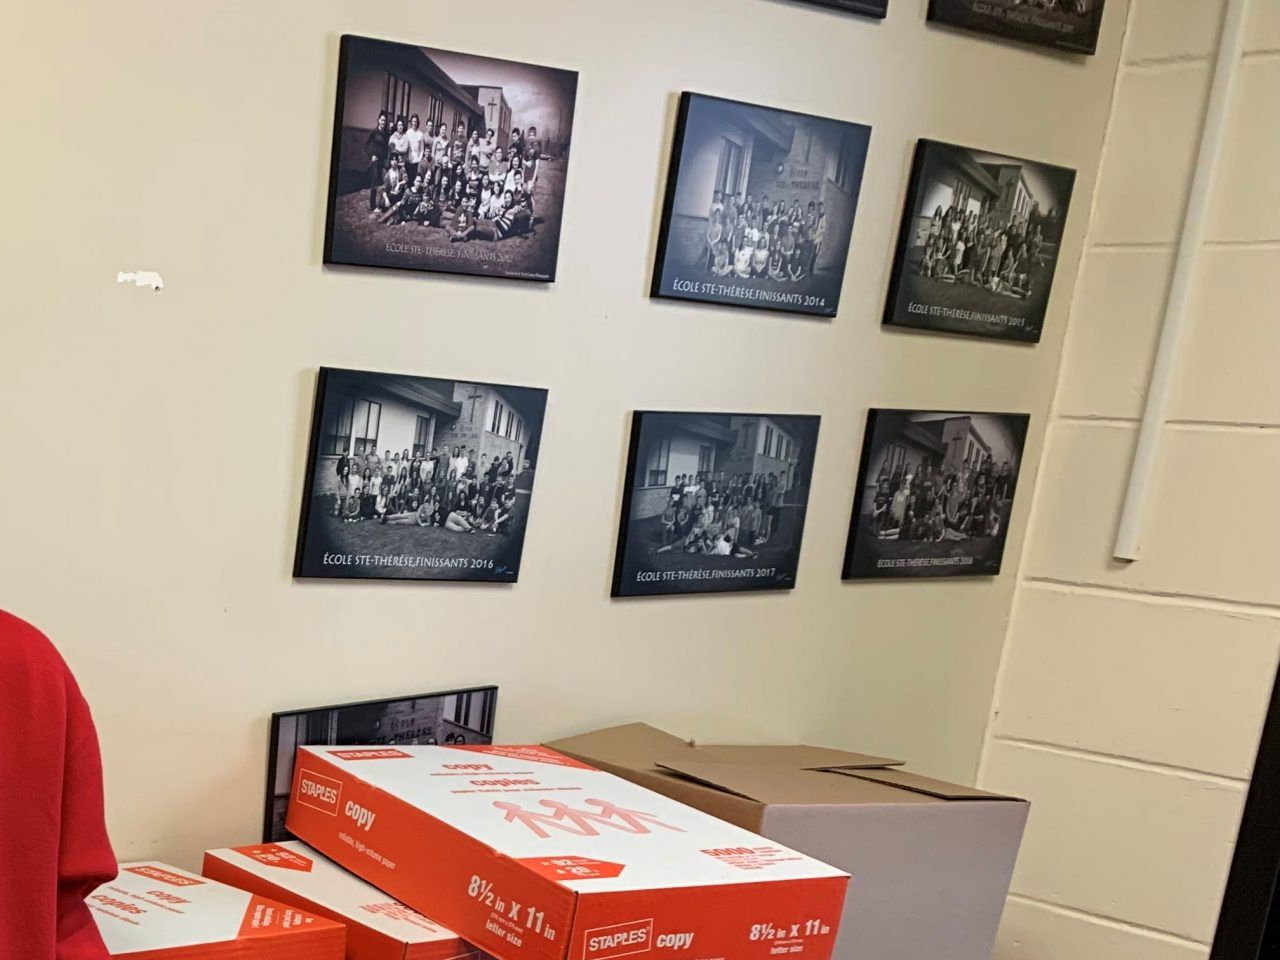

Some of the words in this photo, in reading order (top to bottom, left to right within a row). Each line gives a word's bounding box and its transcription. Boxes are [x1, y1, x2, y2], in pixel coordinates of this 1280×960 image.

[673, 277, 699, 293] ÉCOLE
[804, 295, 825, 306] 2014
[908, 302, 928, 314] ÉCOLE
[323, 552, 352, 565] ÉCOLE
[470, 559, 494, 568] 2016
[637, 570, 660, 581] ÉCOLE
[756, 568, 776, 577] 2017
[300, 778, 338, 804] STAPLES
[345, 800, 376, 832] copy
[588, 928, 647, 952] STAPLES
[656, 931, 695, 950] copy
